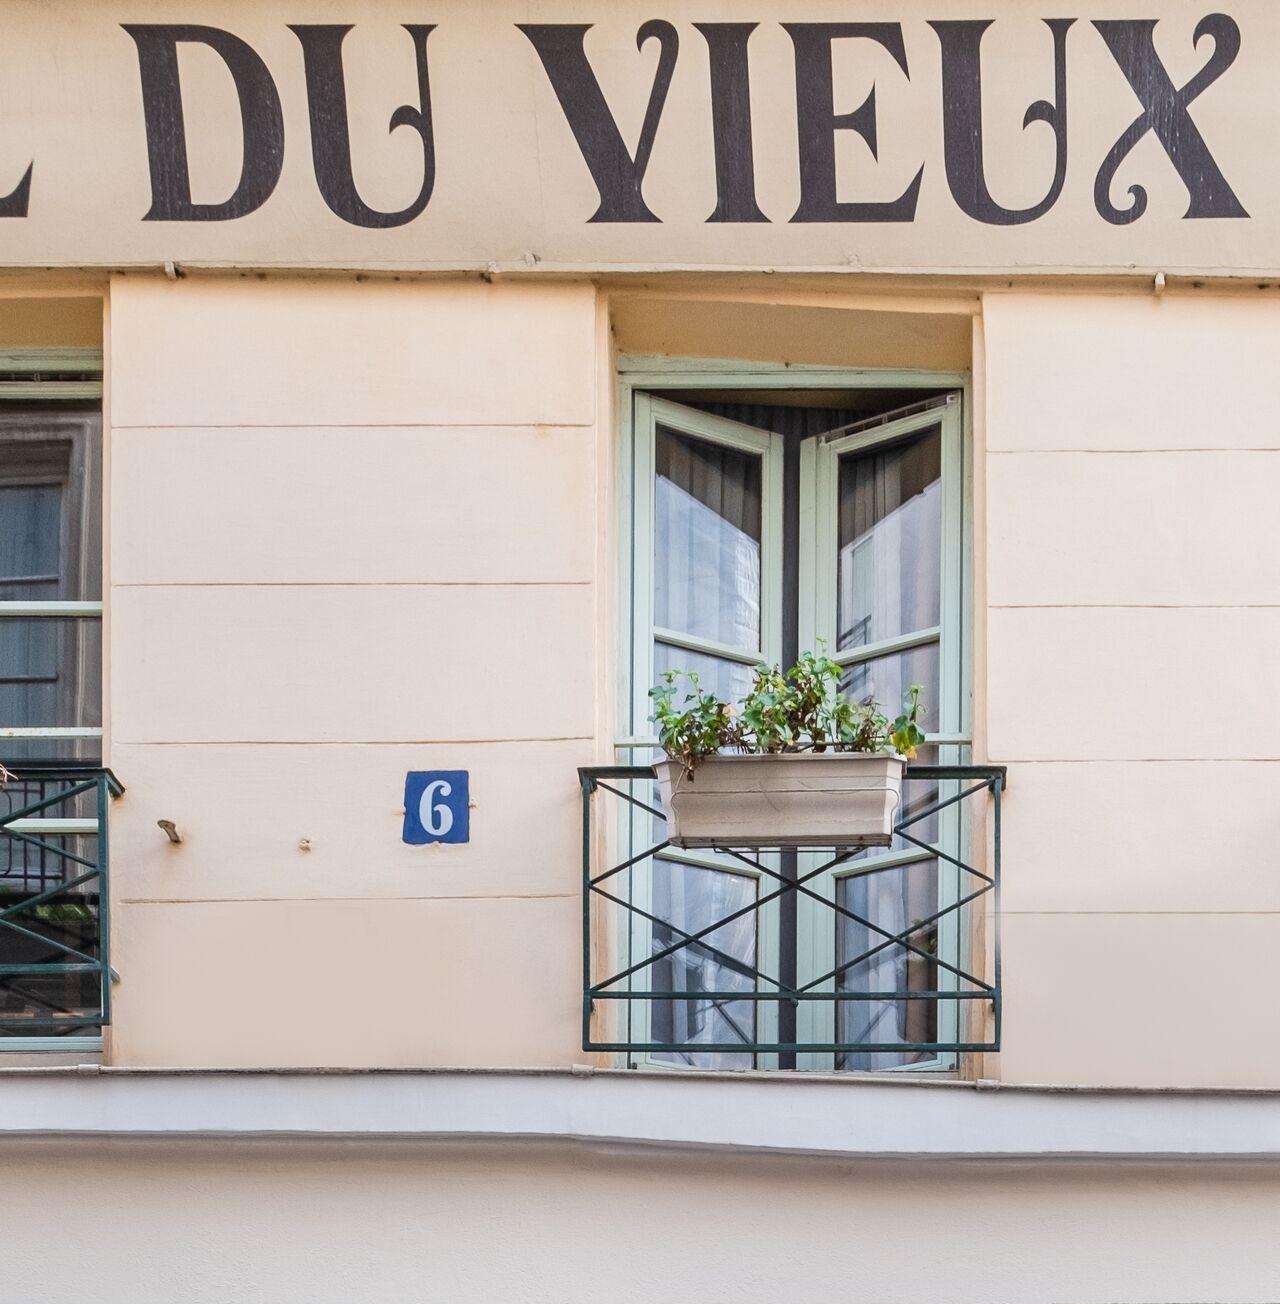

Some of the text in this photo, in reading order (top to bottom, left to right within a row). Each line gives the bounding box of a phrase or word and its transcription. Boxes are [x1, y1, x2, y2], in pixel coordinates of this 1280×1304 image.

[119, 22, 437, 229] DU
[514, 17, 1251, 226] VIEUX
[419, 780, 454, 836] 6
